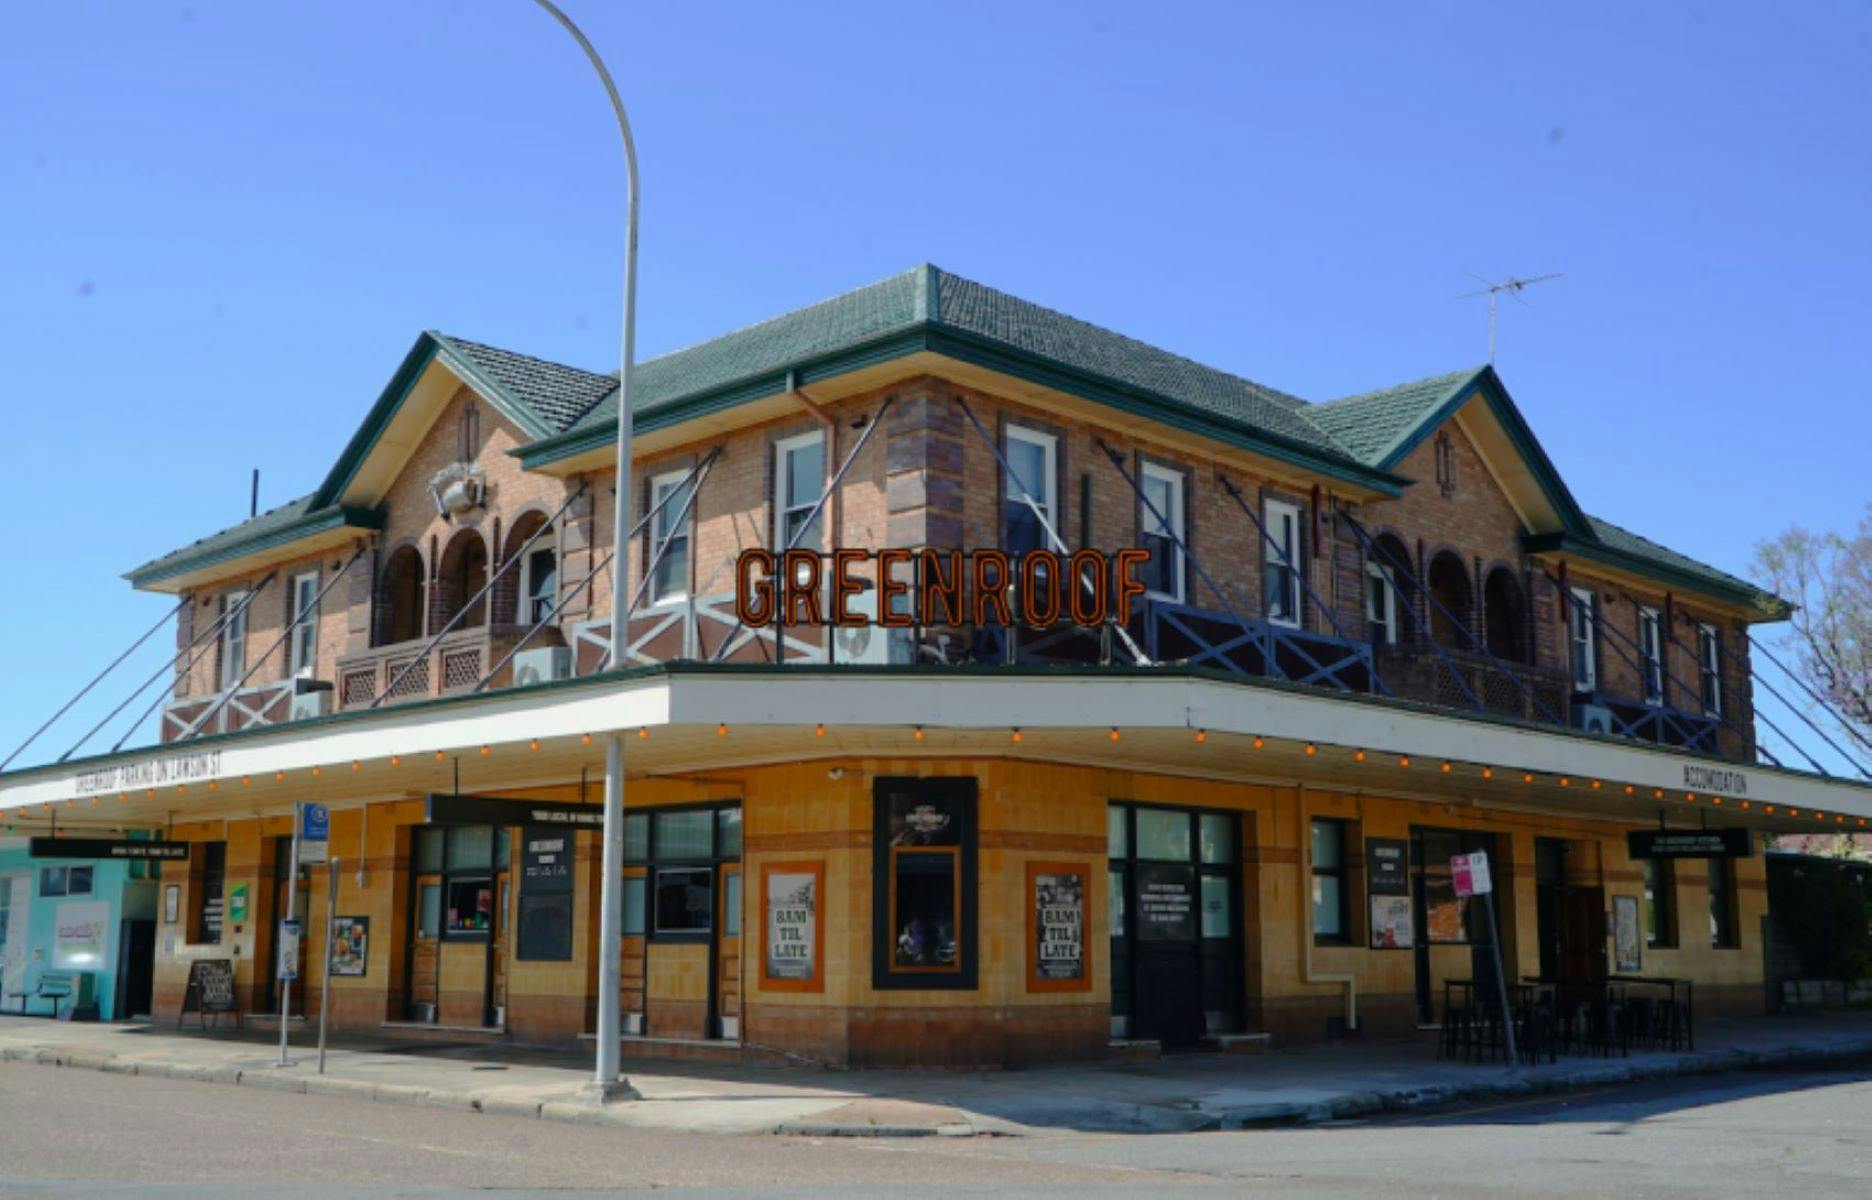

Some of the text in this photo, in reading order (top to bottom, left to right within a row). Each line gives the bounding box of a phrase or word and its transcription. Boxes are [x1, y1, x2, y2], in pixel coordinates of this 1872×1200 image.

[736, 548, 1151, 628] GREENROOF
[156, 759, 168, 783] ON
[210, 750, 221, 775] ST
[776, 910, 807, 924] 8AM
[1045, 910, 1075, 924] 8AM
[774, 944, 808, 957] LATE
[1044, 944, 1077, 957] LATE
